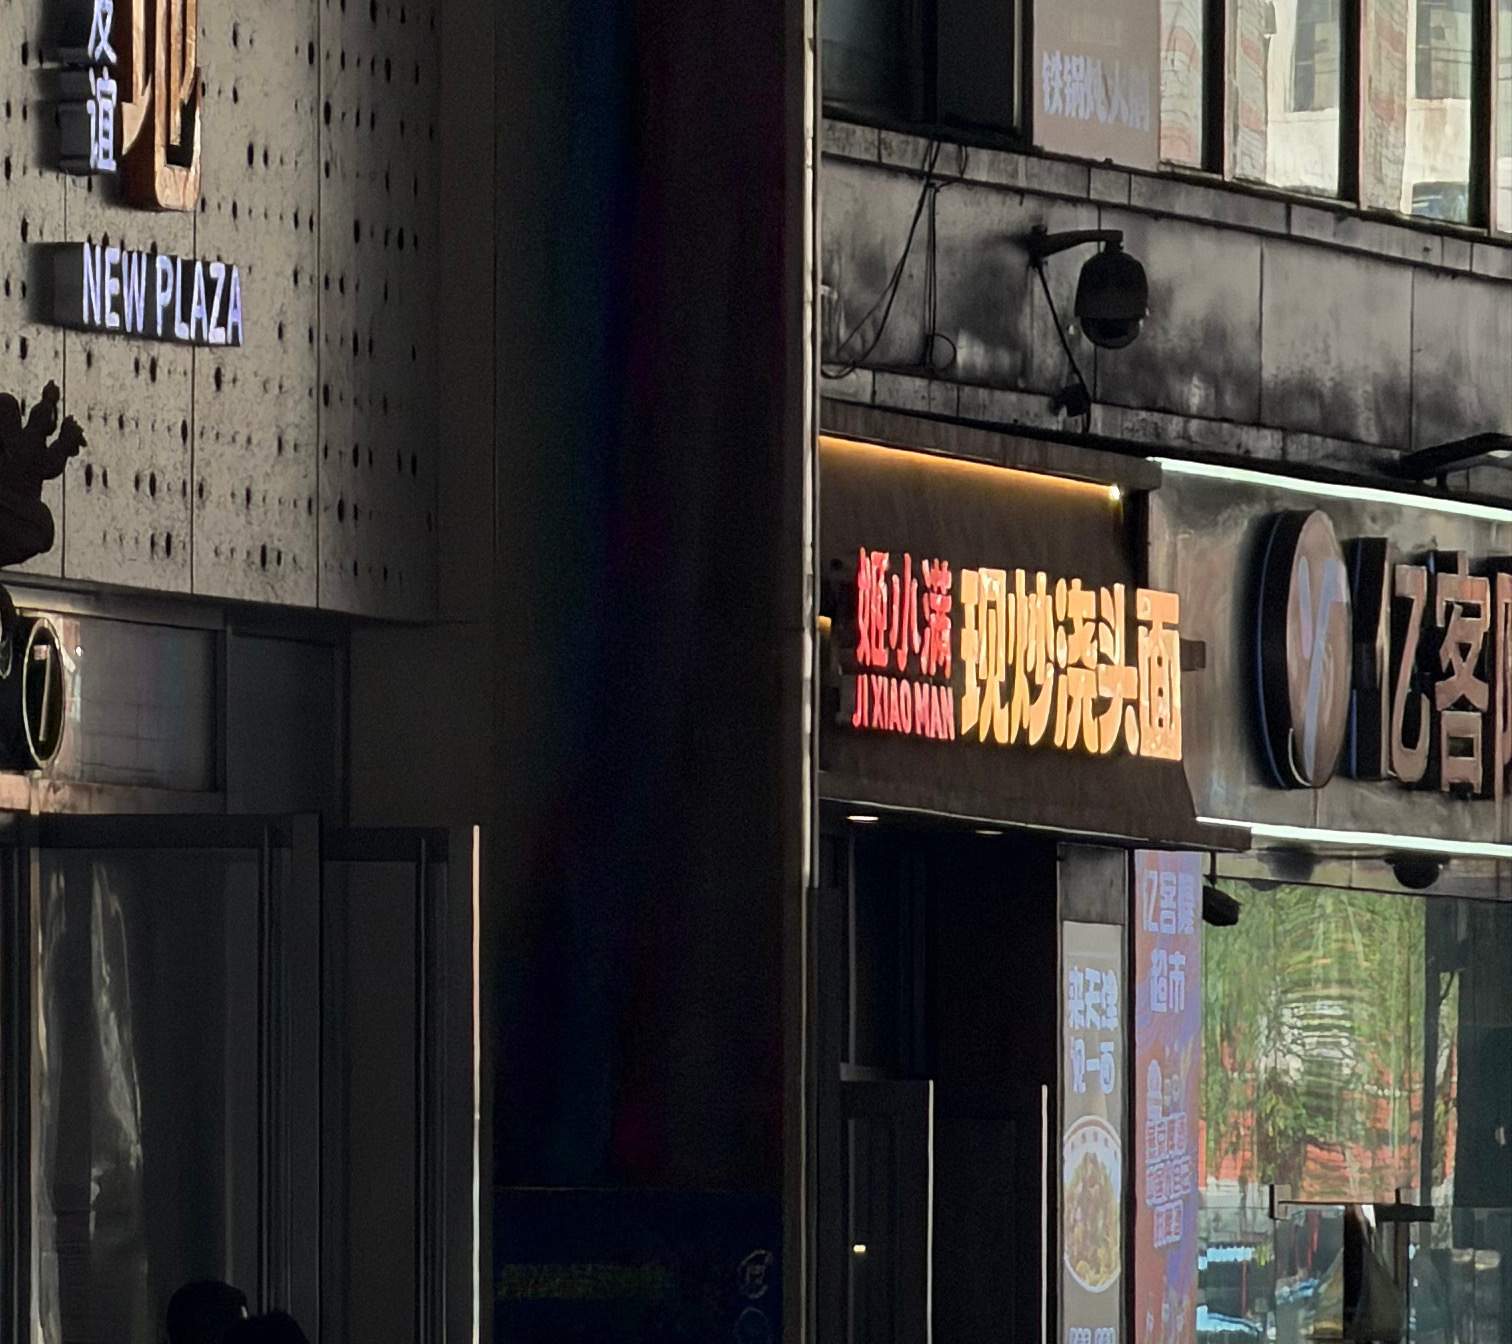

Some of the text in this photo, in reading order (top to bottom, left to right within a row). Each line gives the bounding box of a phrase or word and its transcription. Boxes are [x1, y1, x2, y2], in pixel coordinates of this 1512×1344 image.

[83, 244, 243, 345] NEW PLAZA
[857, 546, 952, 679] 姬小满
[960, 567, 1182, 761] 现炒浇头面
[1376, 536, 1512, 806] 亿客
[852, 674, 955, 740] JI XIAO MAN
[1150, 947, 1186, 1014] 超市
